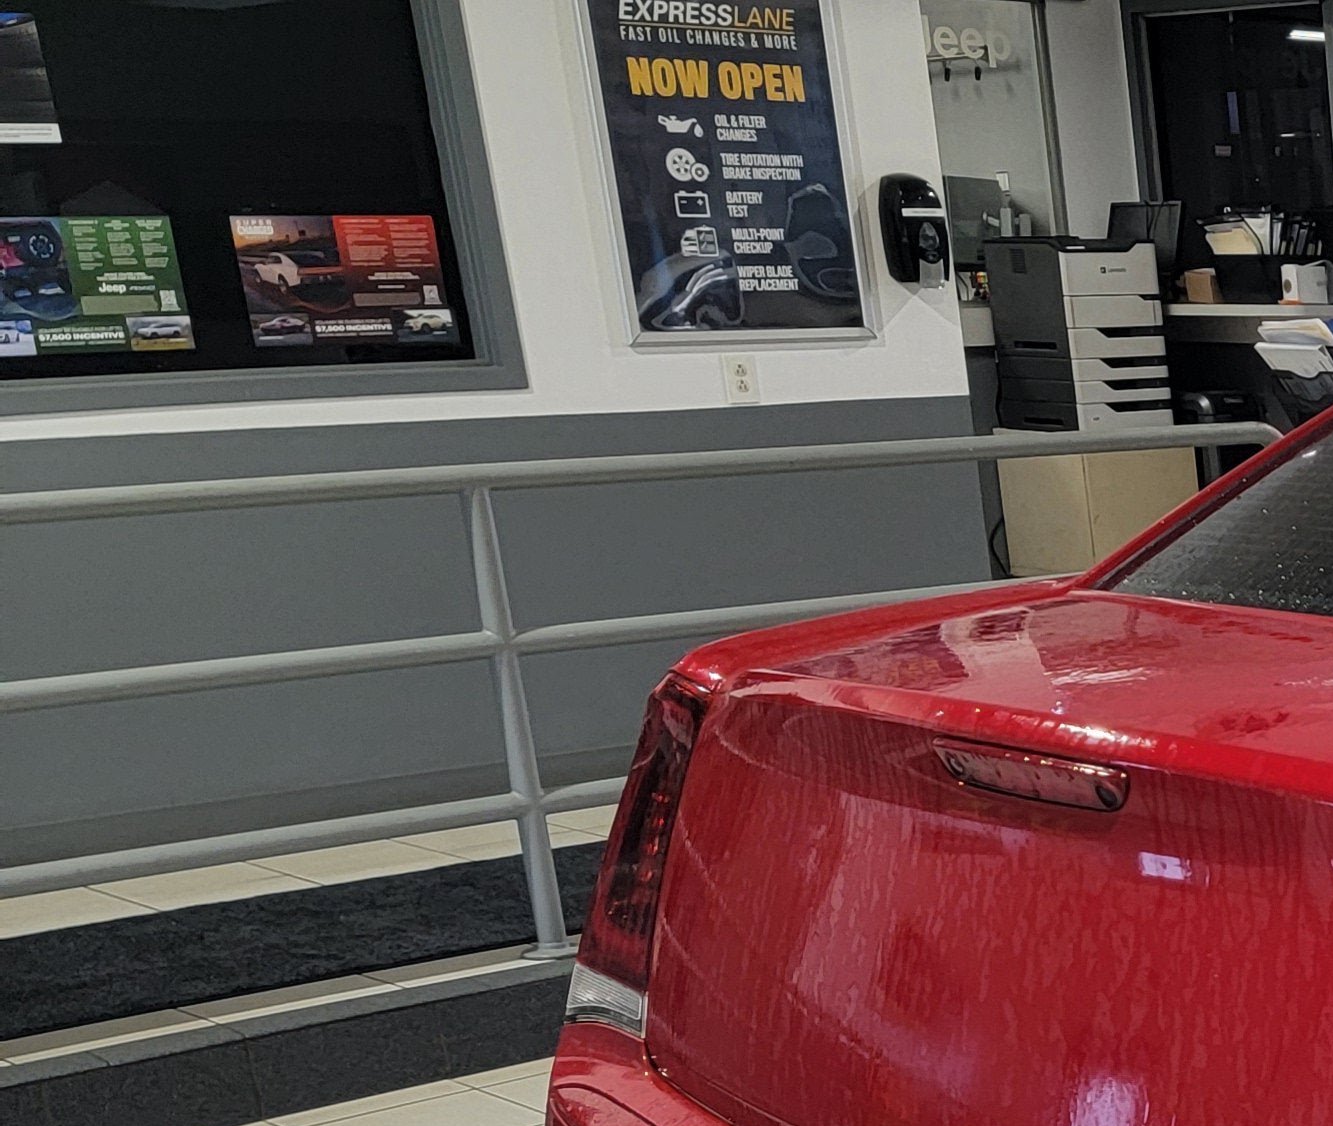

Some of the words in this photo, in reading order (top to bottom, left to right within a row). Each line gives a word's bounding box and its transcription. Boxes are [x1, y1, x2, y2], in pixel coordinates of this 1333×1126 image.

[618, 0, 796, 30] EXPRESSLANE
[619, 25, 652, 42] FAST
[658, 27, 681, 43] OIL
[686, 29, 745, 48] CHANGES
[749, 35, 759, 48] &
[763, 34, 798, 50] MORE
[626, 57, 709, 99] NOW
[717, 61, 806, 103] OPEN
[714, 114, 730, 127] OIL
[730, 115, 738, 127] &
[738, 115, 767, 128] FILTER
[716, 128, 758, 142] CHANGES
[720, 153, 740, 165] TIRE
[740, 153, 781, 167] ROTATION
[781, 154, 804, 167] WITH
[722, 167, 752, 180] BRAKE
[752, 168, 801, 181] INSPECTION
[725, 191, 763, 204] BATTERY
[727, 205, 748, 218] TEST
[731, 228, 785, 241] MULTI-POINT
[734, 241, 773, 254] CHECKUP
[737, 265, 766, 278] WIPER
[766, 265, 794, 278] BLADE
[98, 282, 127, 294] Jeep
[739, 278, 799, 292] REPLACEMENT
[345, 323, 393, 332] INCENTIVE
[38, 332, 71, 343] $7,500
[72, 331, 125, 341] INCENTIVE
